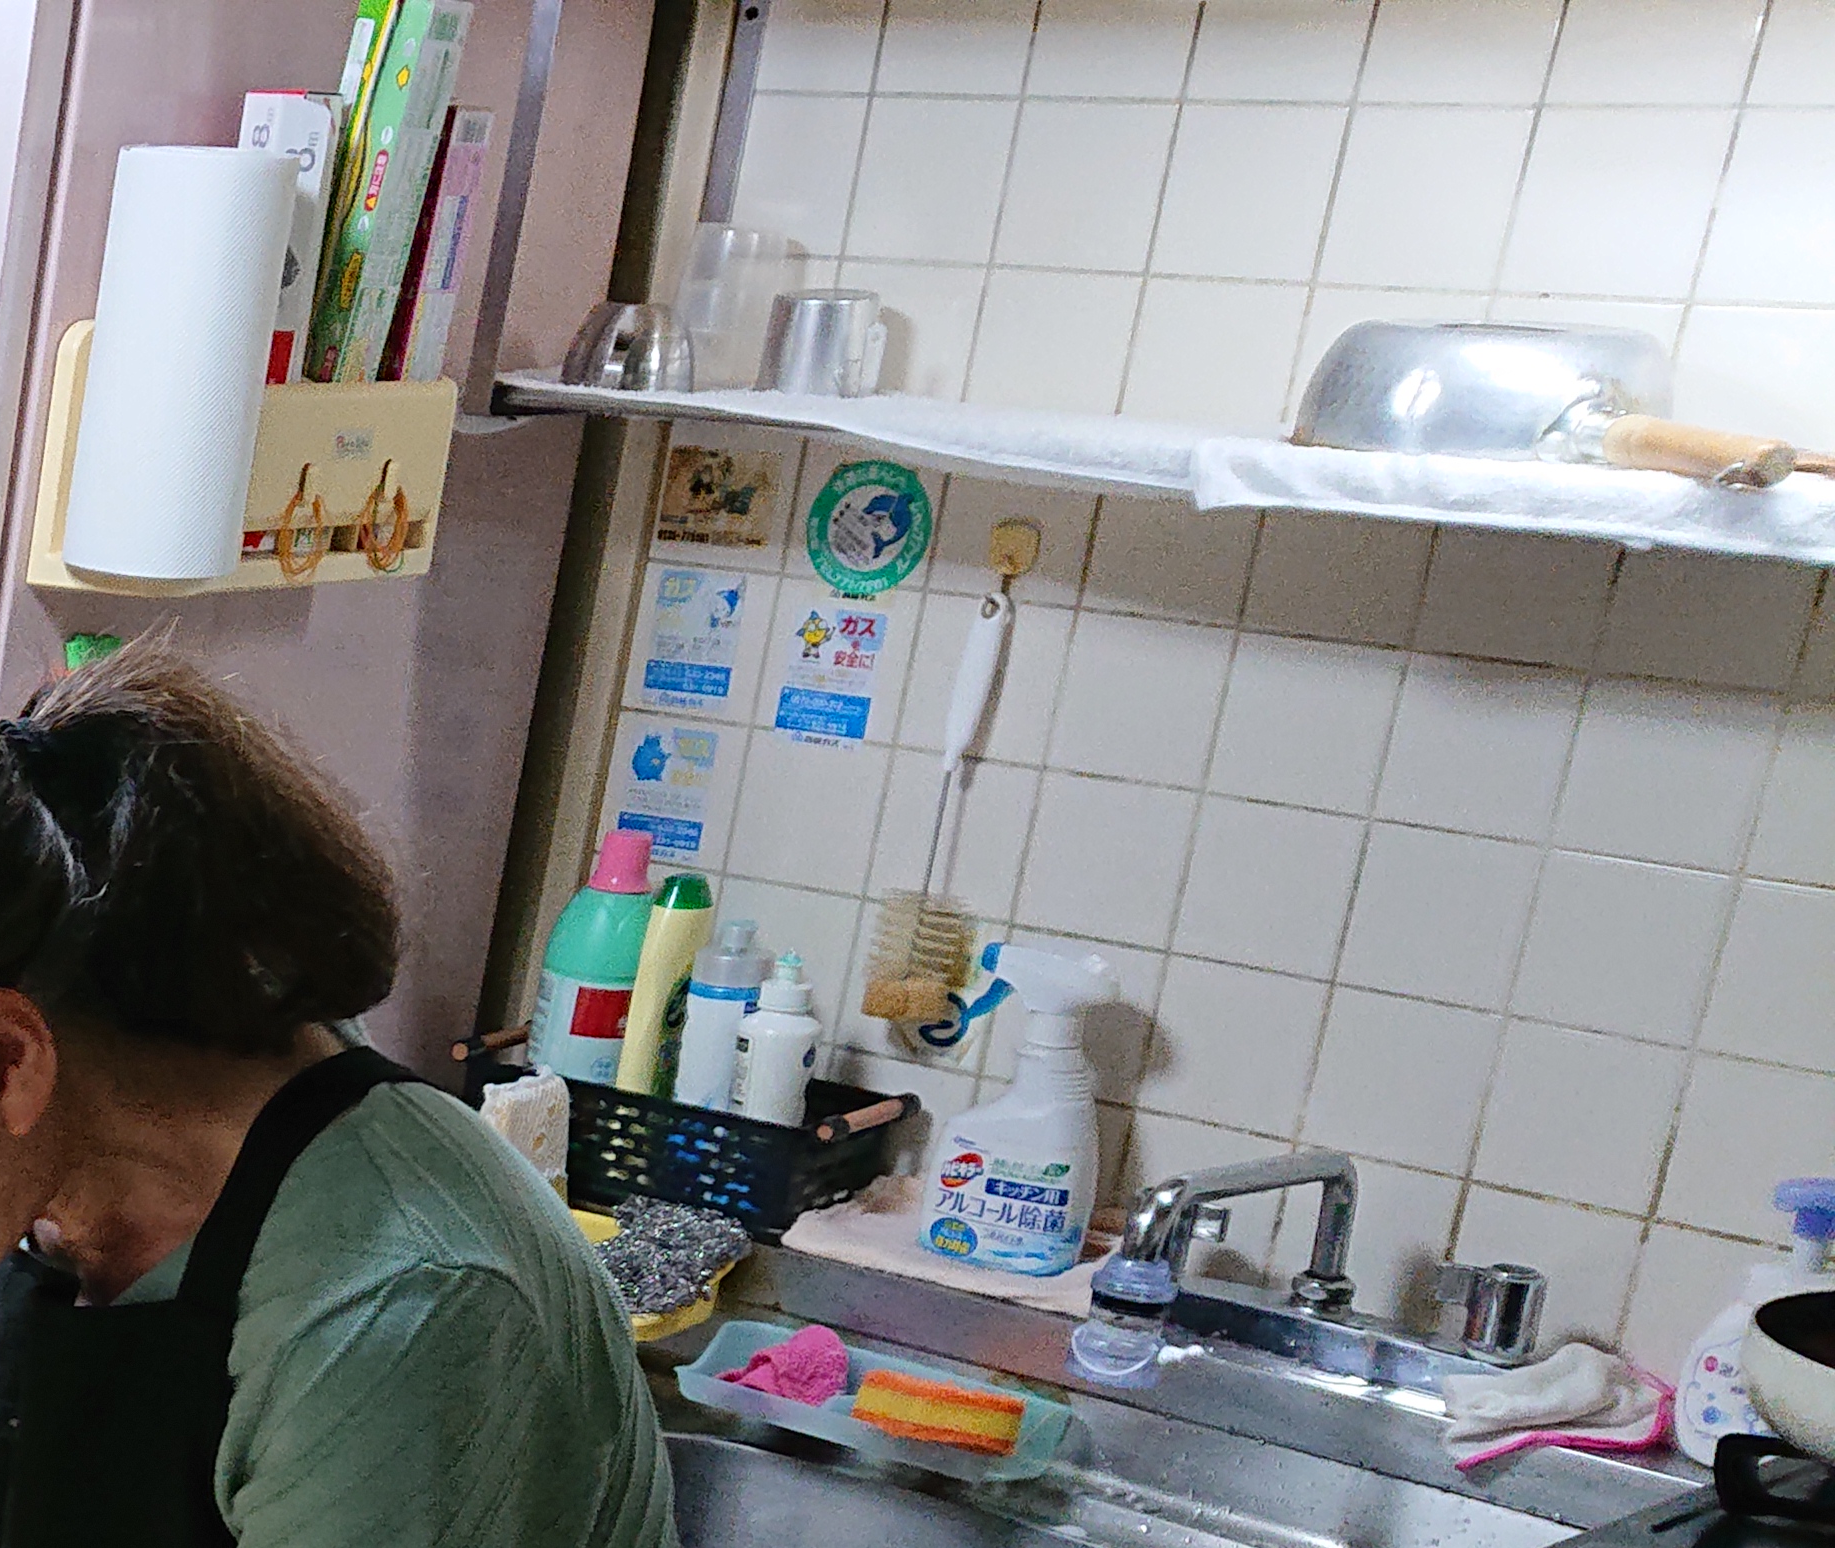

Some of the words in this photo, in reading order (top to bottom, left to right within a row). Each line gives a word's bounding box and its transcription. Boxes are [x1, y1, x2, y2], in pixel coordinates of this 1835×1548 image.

[840, 615, 876, 637] ガス
[995, 1182, 1061, 1204] キッチン用
[935, 1187, 1068, 1233] アルコール除菌
